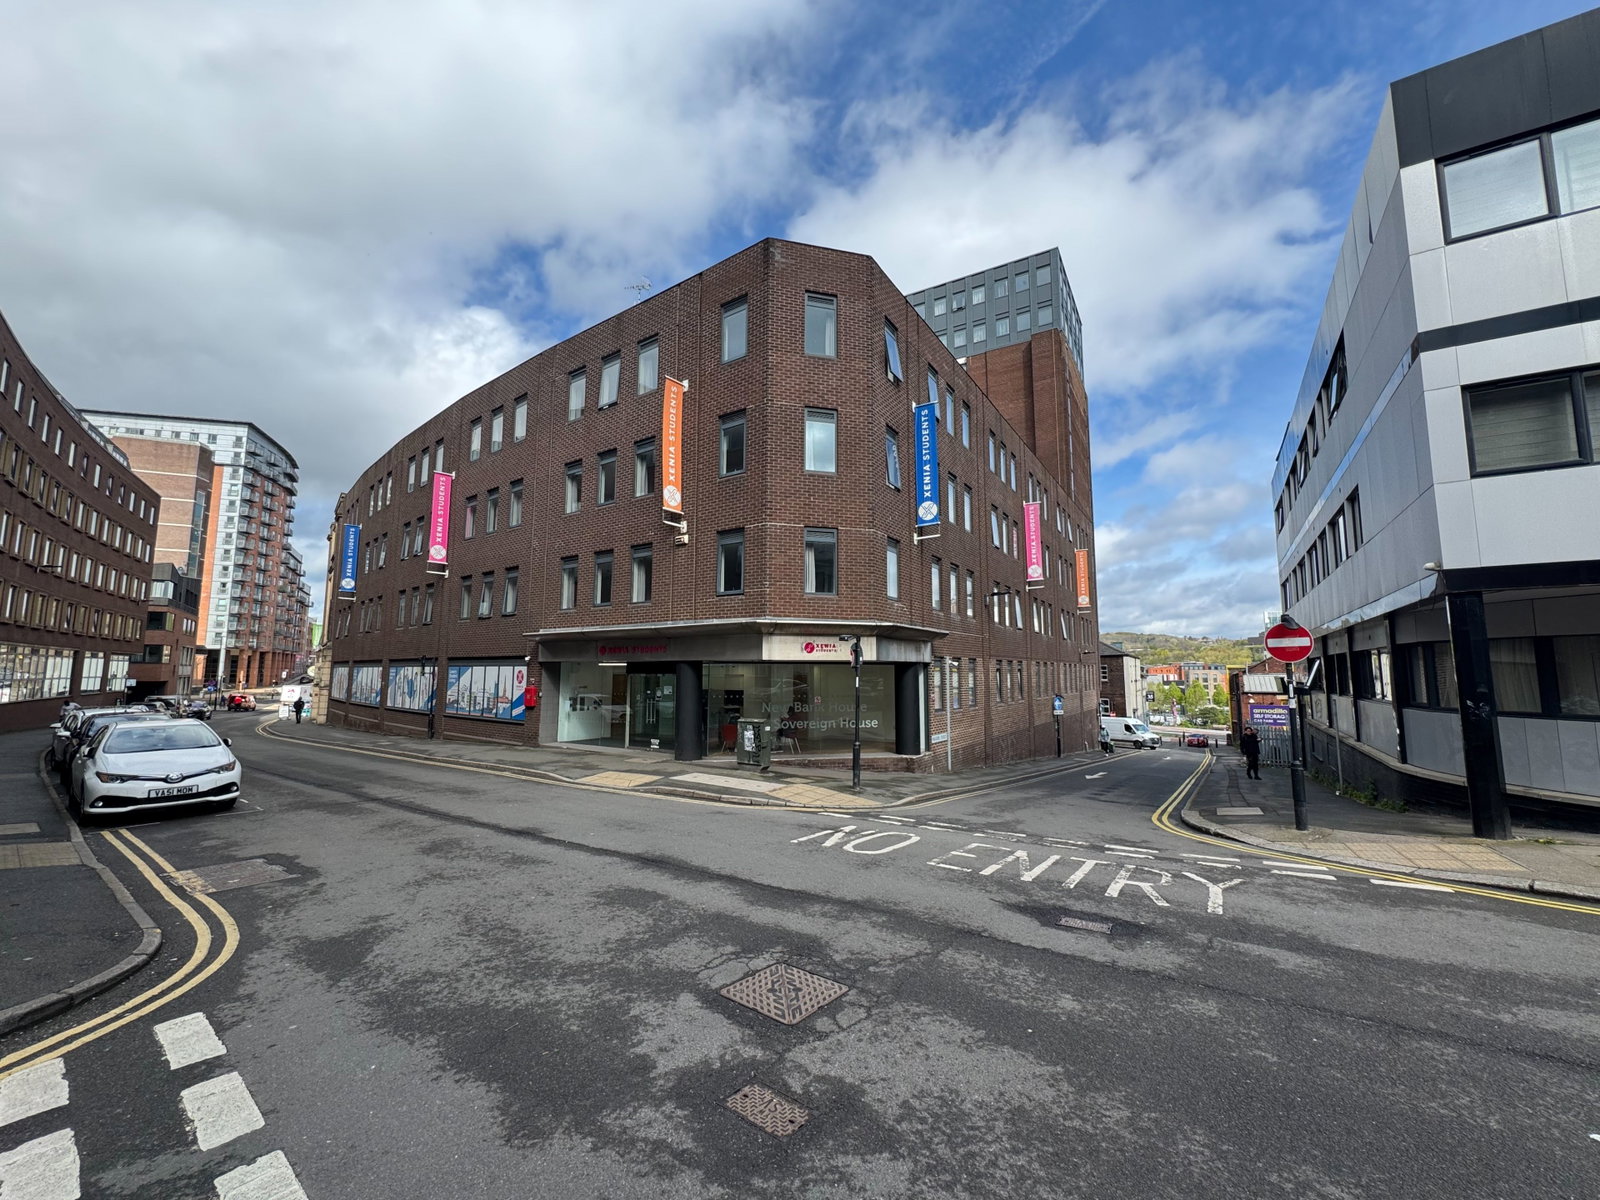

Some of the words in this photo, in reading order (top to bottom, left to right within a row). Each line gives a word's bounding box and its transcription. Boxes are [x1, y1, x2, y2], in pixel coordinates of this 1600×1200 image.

[668, 386, 678, 441] STUDENTS
[921, 409, 931, 461] STUDENTS
[668, 446, 676, 482] XENIA
[923, 464, 932, 498] XENIA
[437, 476, 446, 515] STUDENTS
[347, 528, 355, 556] STUDENTS
[436, 517, 444, 543] XENIA
[1030, 541, 1038, 563] XENIA
[794, 701, 825, 713] Bank
[829, 701, 868, 713] Houe
[775, 719, 837, 732] Sovereign
[790, 825, 921, 855] NO
[926, 842, 1246, 915] ENTRY
